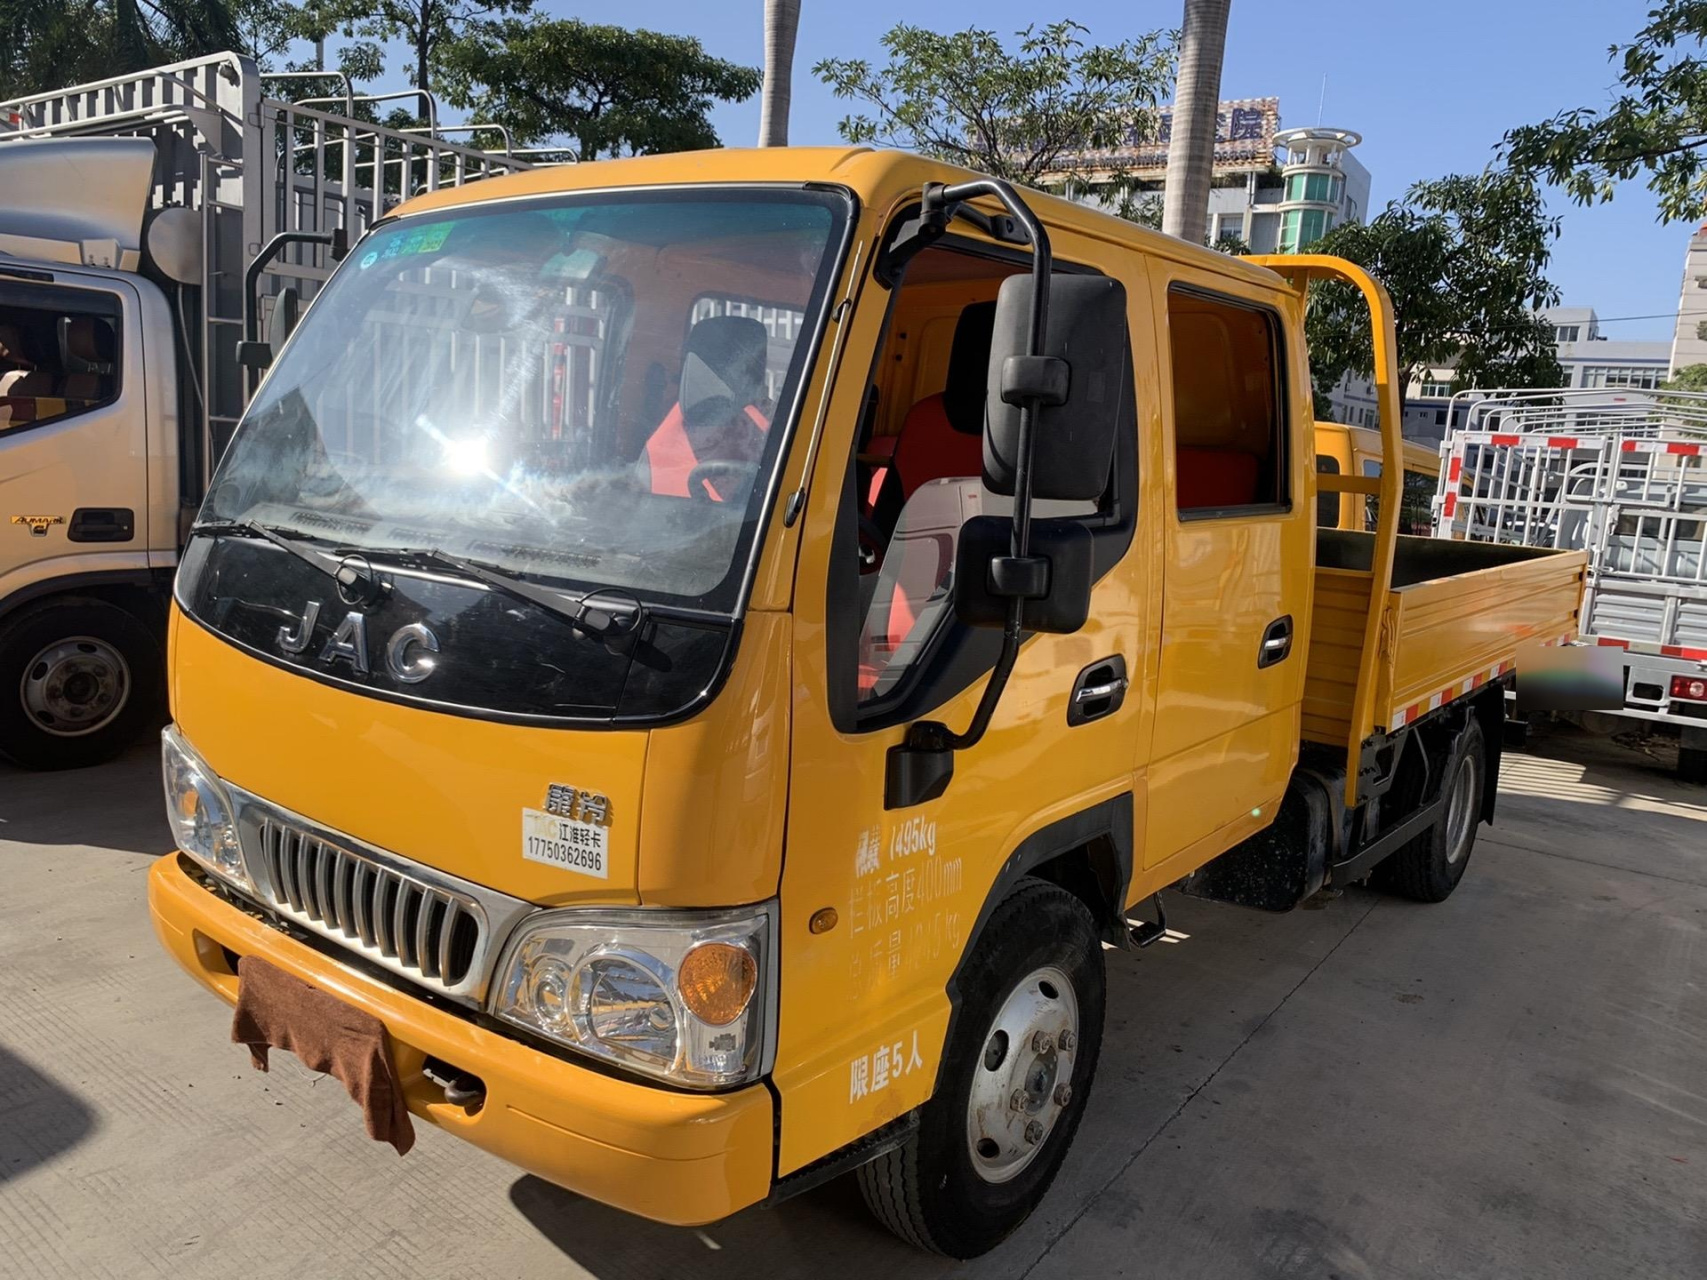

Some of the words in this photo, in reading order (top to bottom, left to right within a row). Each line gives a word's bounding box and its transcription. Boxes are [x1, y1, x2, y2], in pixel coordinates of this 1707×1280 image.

[276, 600, 441, 685] JAC
[528, 836, 602, 871] 17750362696
[559, 823, 601, 848] 江淮轻卡
[889, 814, 937, 862] 1495kg
[849, 1029, 923, 1104] 限座5人
